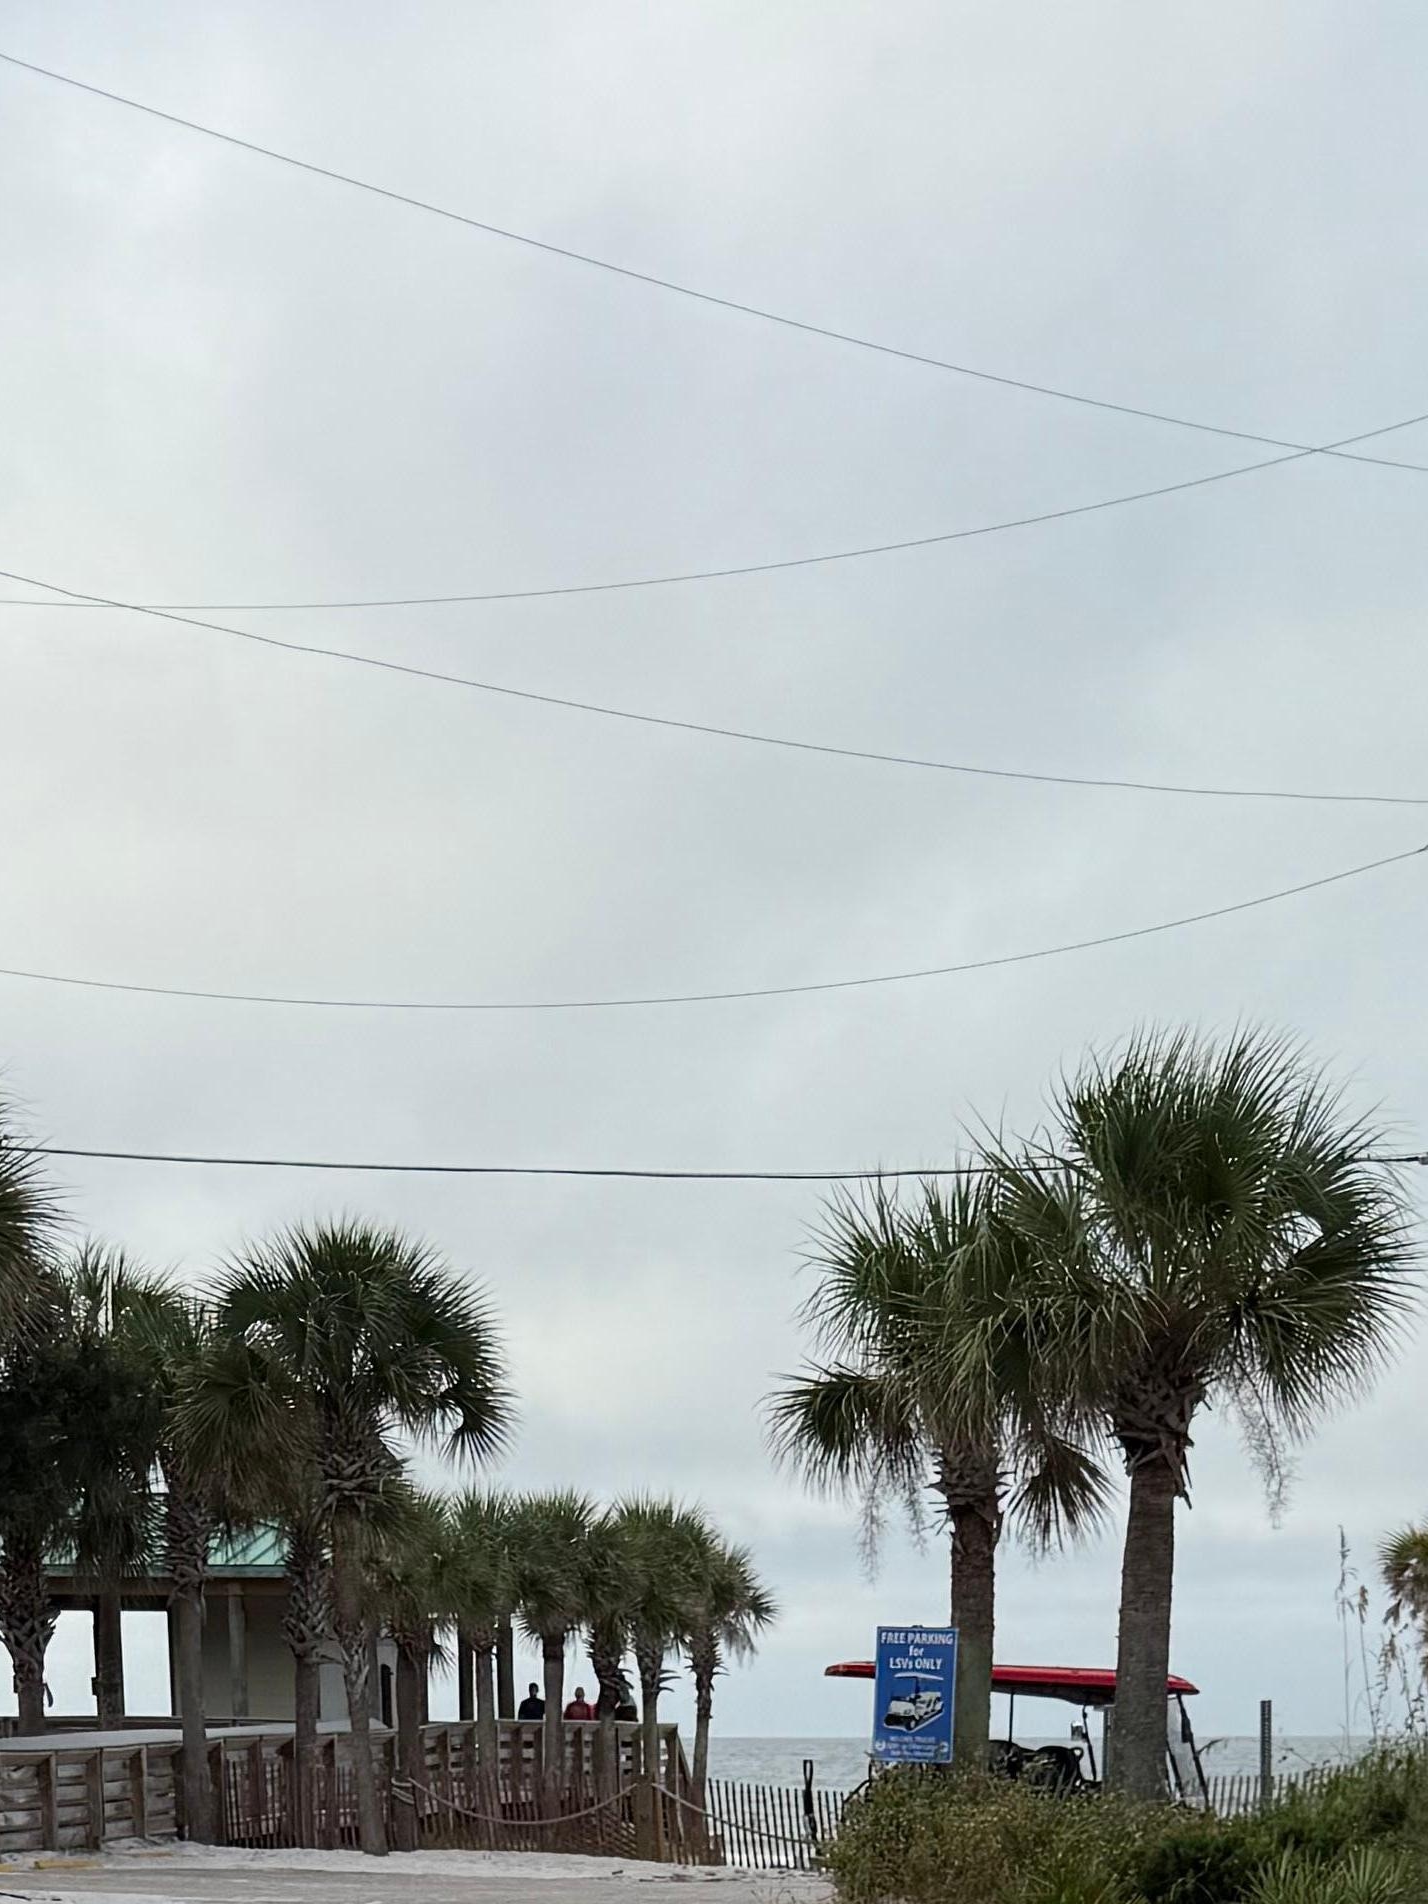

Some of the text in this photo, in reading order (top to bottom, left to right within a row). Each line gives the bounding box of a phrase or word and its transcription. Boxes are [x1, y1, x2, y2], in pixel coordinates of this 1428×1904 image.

[880, 1632, 954, 1646] FREE PARKING
[909, 1645, 925, 1657] for
[915, 1658, 943, 1670] ONLY
